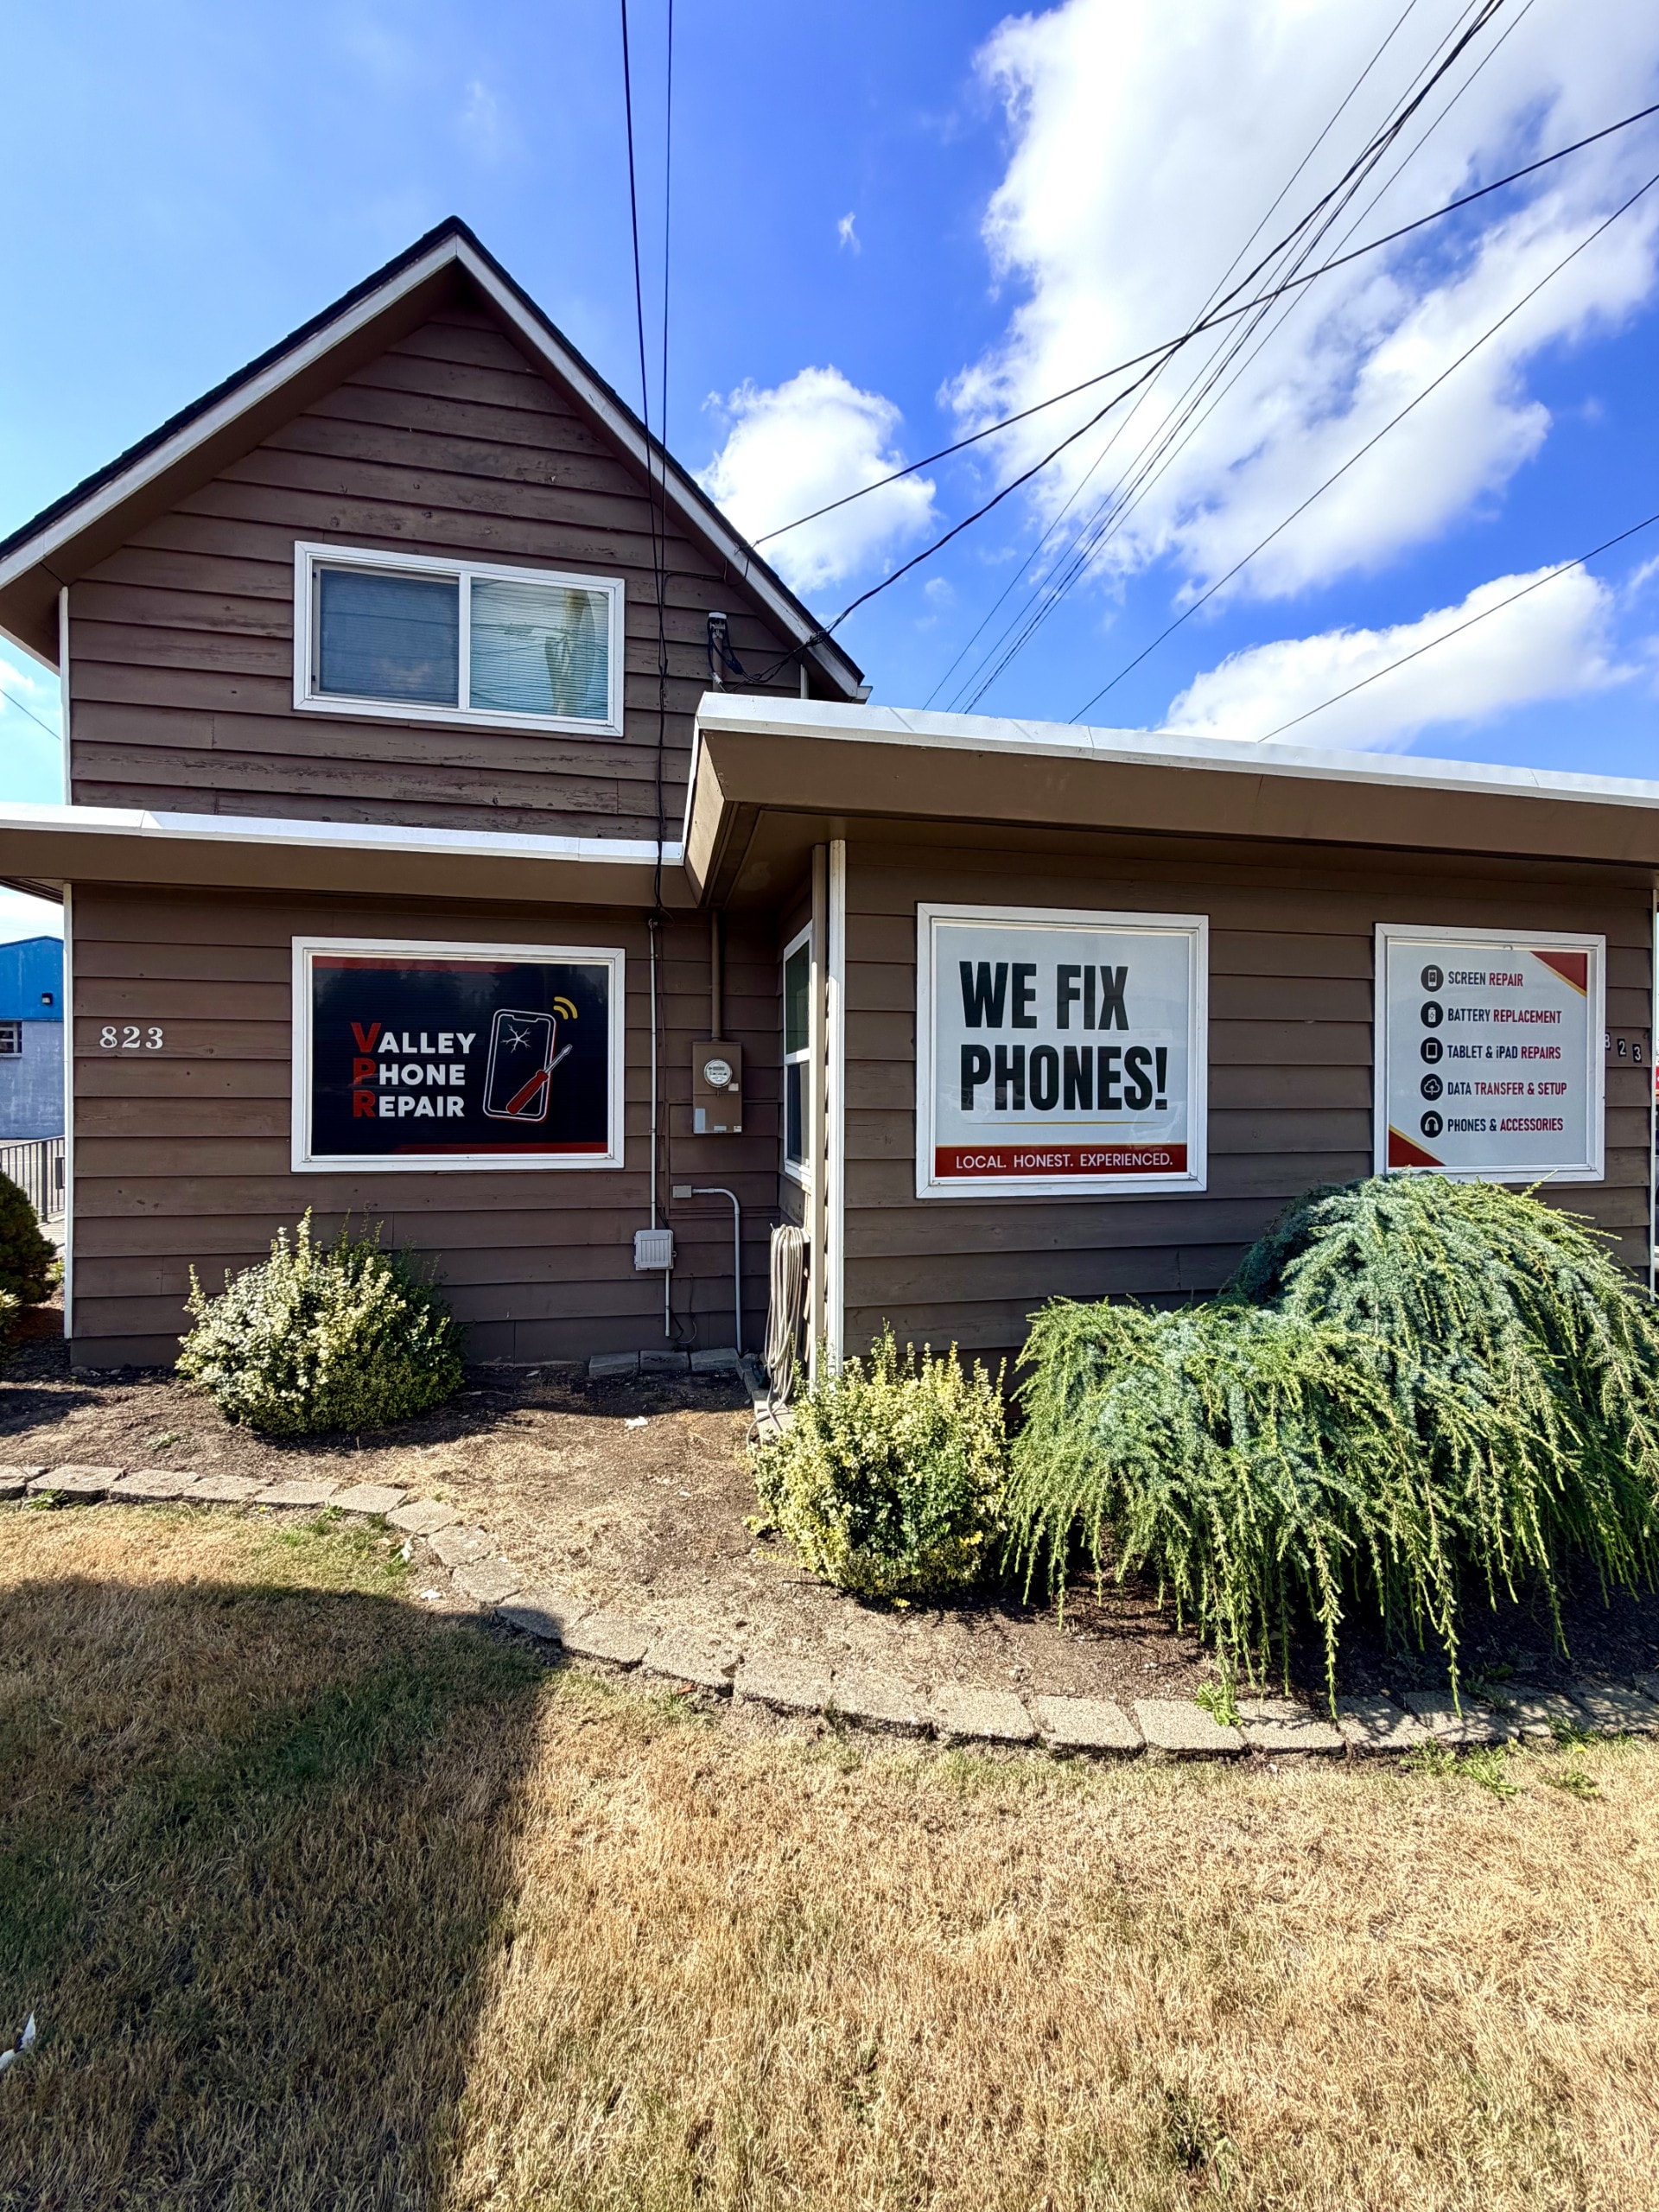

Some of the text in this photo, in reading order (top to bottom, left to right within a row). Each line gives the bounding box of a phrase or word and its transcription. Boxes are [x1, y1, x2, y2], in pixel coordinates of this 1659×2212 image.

[1448, 971, 1523, 987] SCREEN REPAIR
[959, 961, 1129, 1030] WE FIX
[1447, 1008, 1562, 1024] BATTERY REPLACEMENT
[99, 1026, 163, 1049] 823
[351, 1022, 477, 1053] VALLEY
[1605, 1033, 1642, 1061] 823
[1447, 1045, 1561, 1059] TABLET & iPAD REPAIRS
[353, 1058, 466, 1086] PHONE
[961, 1044, 1168, 1111] PHONES!
[1447, 1082, 1567, 1096] DATA TRANSFER & SETUP
[353, 1090, 465, 1117] REPAIR
[1447, 1117, 1564, 1132] PHONES & ACCESSORIES
[956, 1153, 1173, 1168] LOCAL. HONEST. EXPERIENCED.
